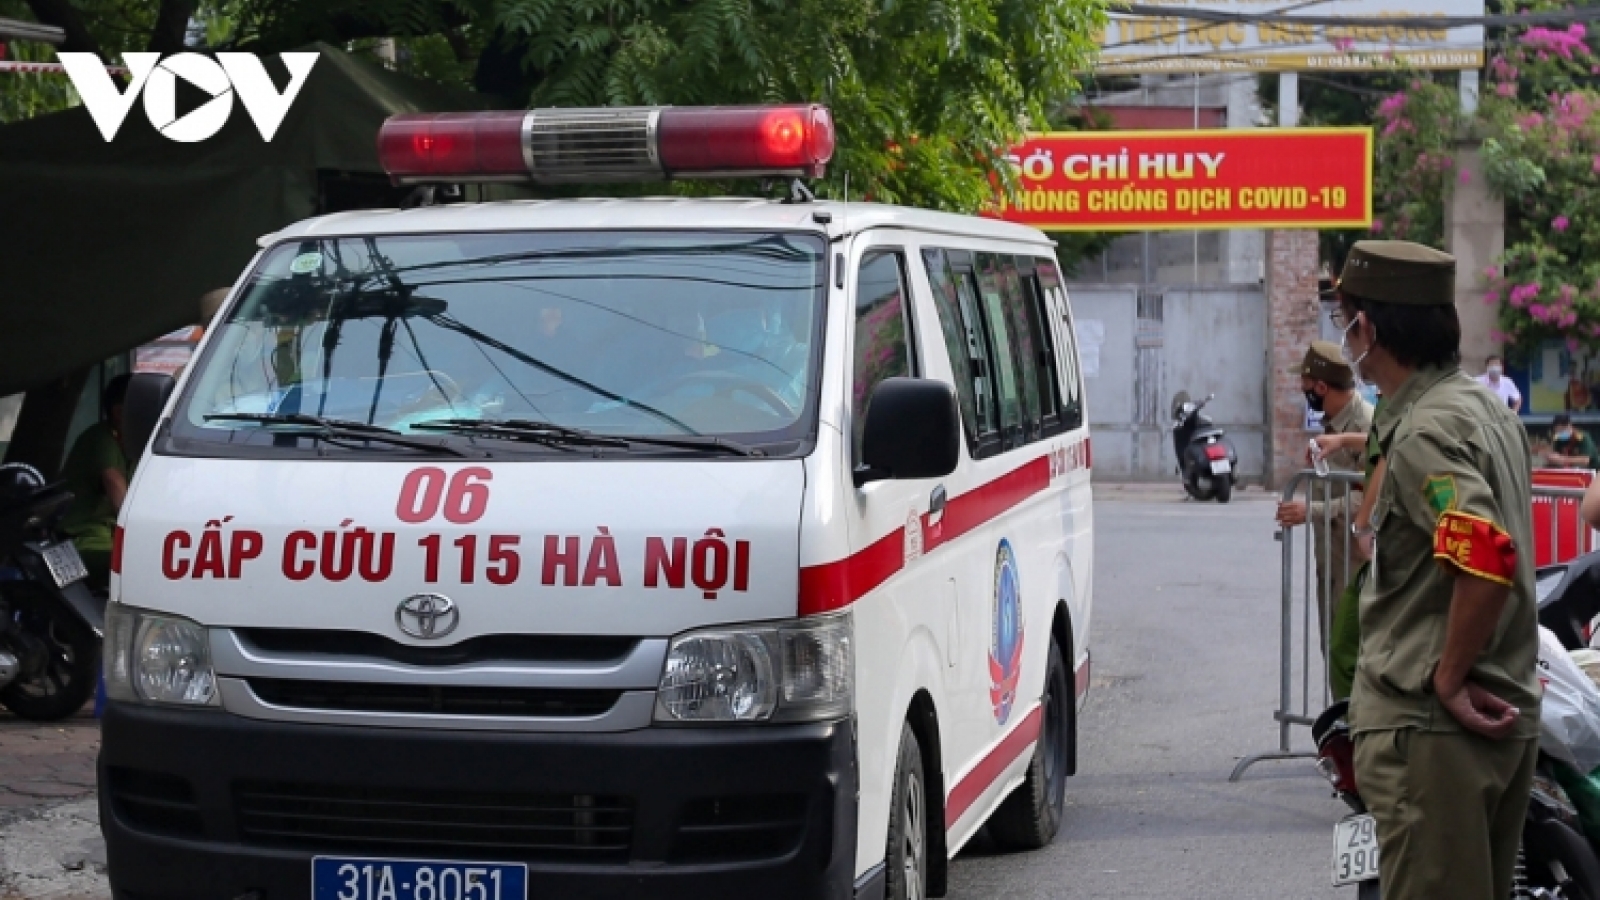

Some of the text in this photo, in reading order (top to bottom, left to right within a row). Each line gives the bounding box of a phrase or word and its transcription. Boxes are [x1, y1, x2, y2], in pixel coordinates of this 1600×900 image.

[1063, 147, 1128, 181] CHỈ
[1137, 152, 1226, 180] HUY
[1087, 181, 1168, 213] CHỐNG
[1175, 187, 1231, 215] DỊCH
[1238, 186, 1307, 211] COVID
[395, 465, 493, 525] 06
[161, 515, 264, 580] CẤP
[281, 518, 396, 583] CỨU
[416, 533, 521, 586] 115
[540, 526, 622, 587] HÀ
[642, 527, 751, 601] NỘI
[1347, 818, 1373, 848] 29
[337, 863, 503, 900] 31A-8051
